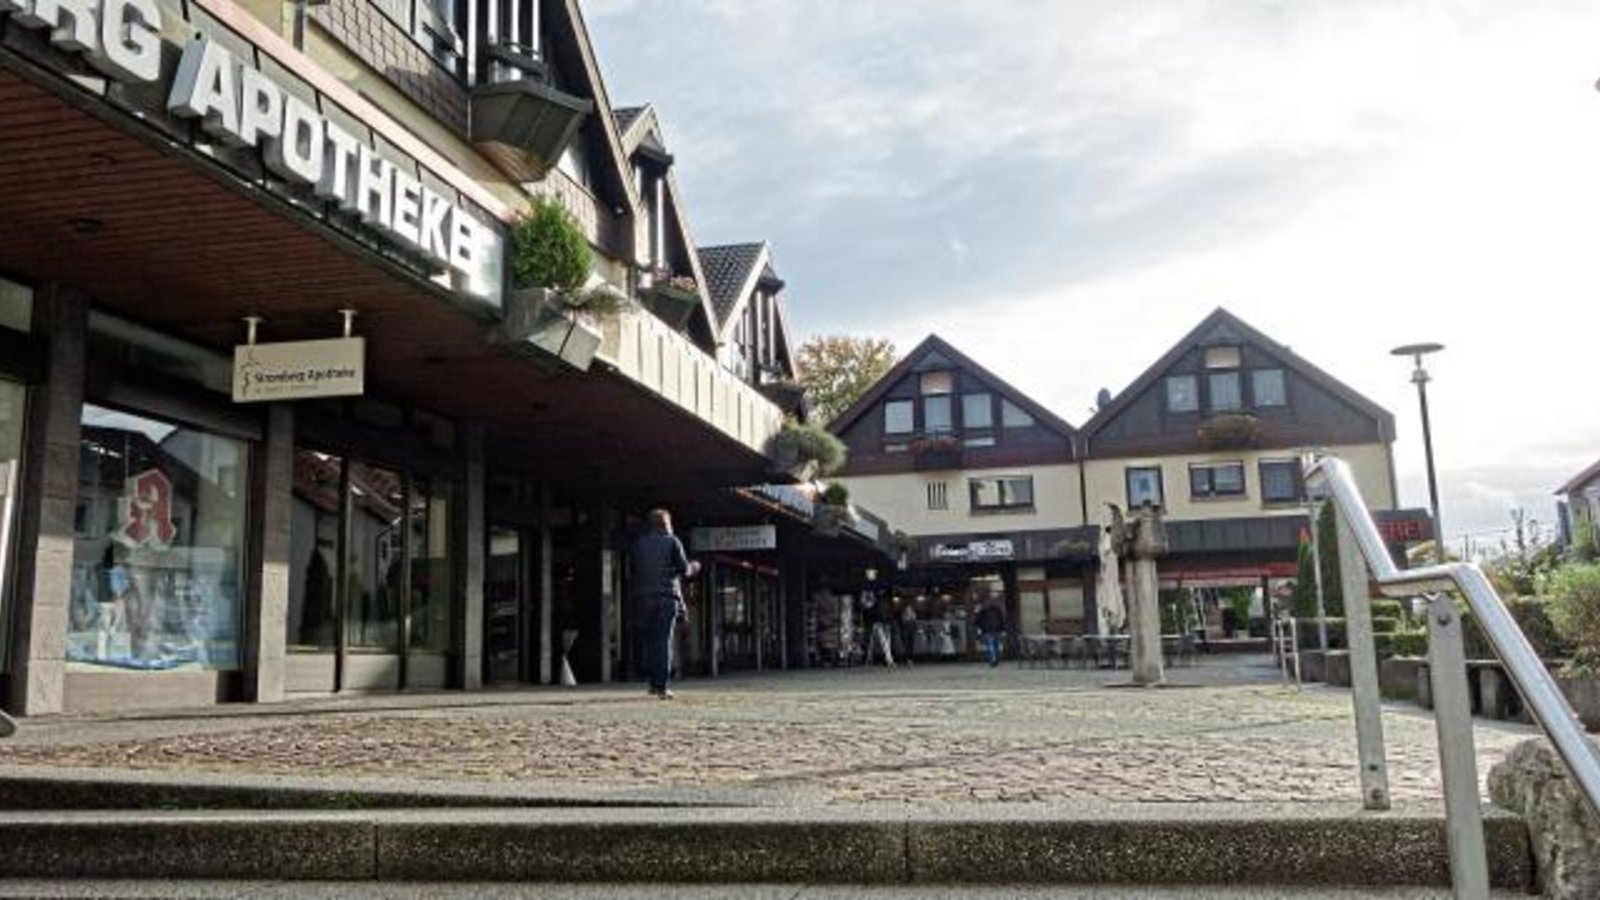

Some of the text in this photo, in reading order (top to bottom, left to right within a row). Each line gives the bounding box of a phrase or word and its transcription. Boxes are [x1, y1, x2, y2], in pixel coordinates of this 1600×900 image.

[10, 0, 478, 280] RG APOTHEKE
[306, 366, 356, 381] Apotheke
